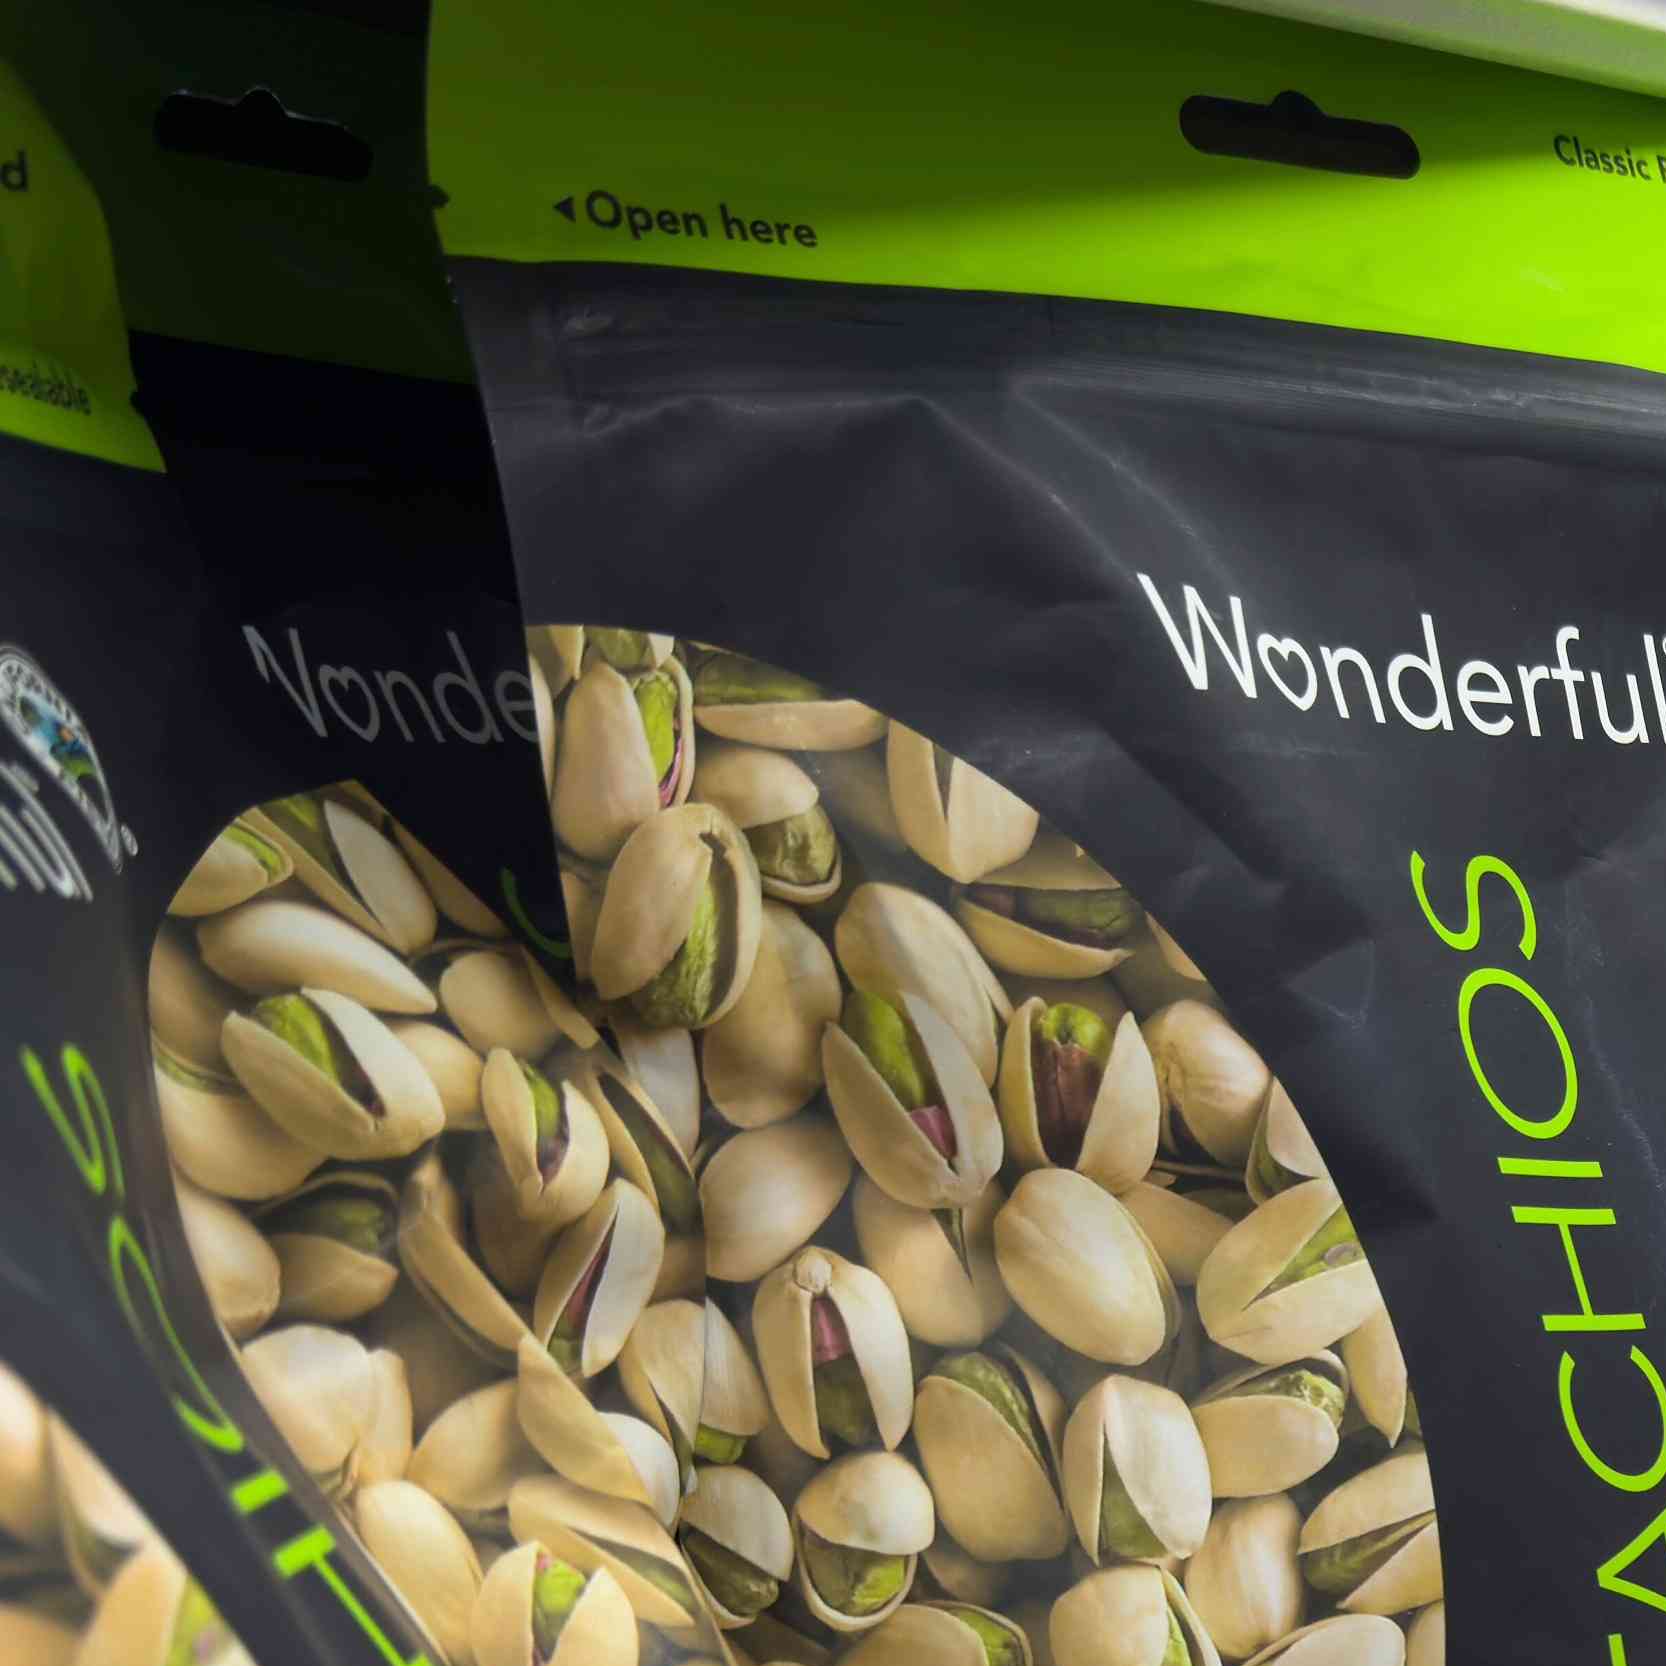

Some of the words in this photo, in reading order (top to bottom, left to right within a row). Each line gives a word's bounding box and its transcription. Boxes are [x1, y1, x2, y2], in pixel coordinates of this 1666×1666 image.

[1552, 133, 1652, 181] Classic
[585, 189, 709, 241] Open
[718, 201, 818, 249] here
